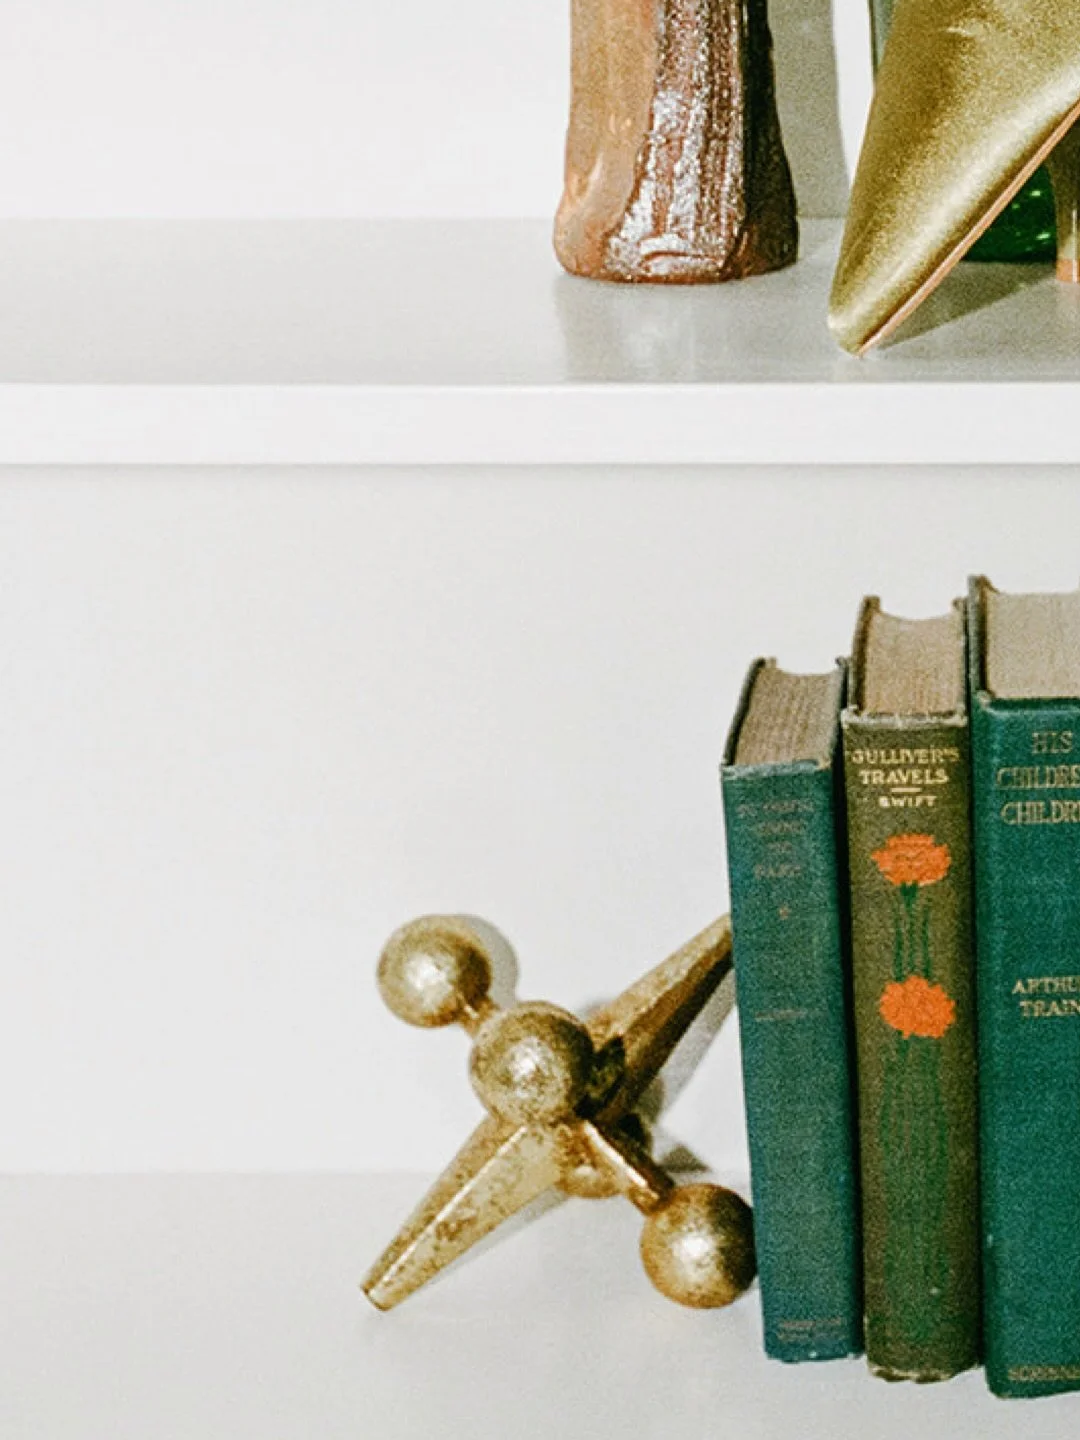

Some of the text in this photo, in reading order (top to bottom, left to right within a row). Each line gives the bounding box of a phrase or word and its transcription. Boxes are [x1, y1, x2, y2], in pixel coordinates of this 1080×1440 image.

[1031, 730, 1074, 755] HIS
[859, 768, 950, 785] TRAVELS
[879, 795, 937, 808] SWIFT
